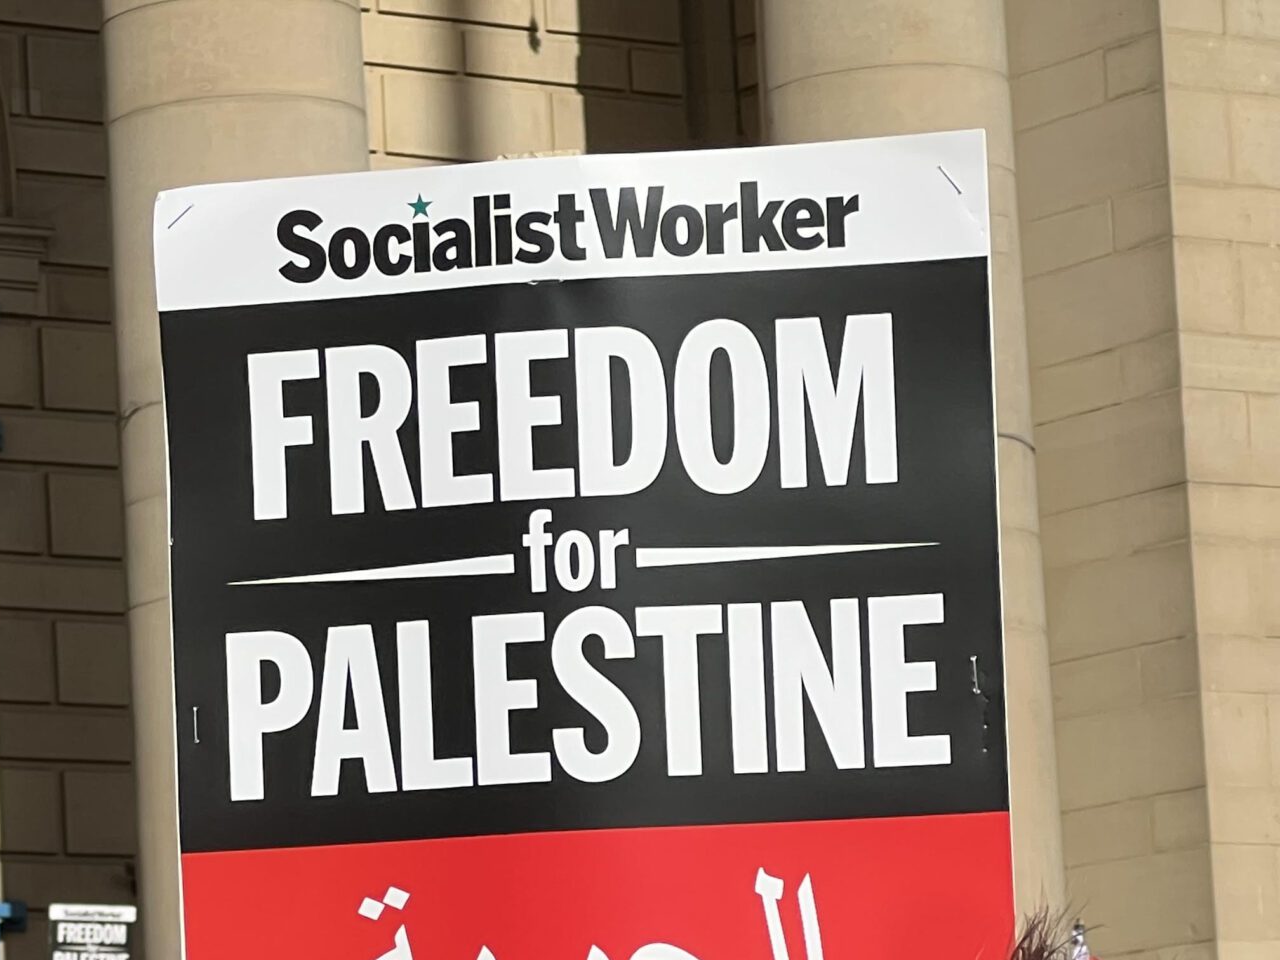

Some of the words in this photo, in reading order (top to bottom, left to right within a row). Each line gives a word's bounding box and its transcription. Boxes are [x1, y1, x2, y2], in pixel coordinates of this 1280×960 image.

[246, 312, 899, 521] FREEDOM
[522, 509, 629, 594] for
[225, 593, 952, 802] PALESTINE
[57, 922, 127, 944] FREEDOM
